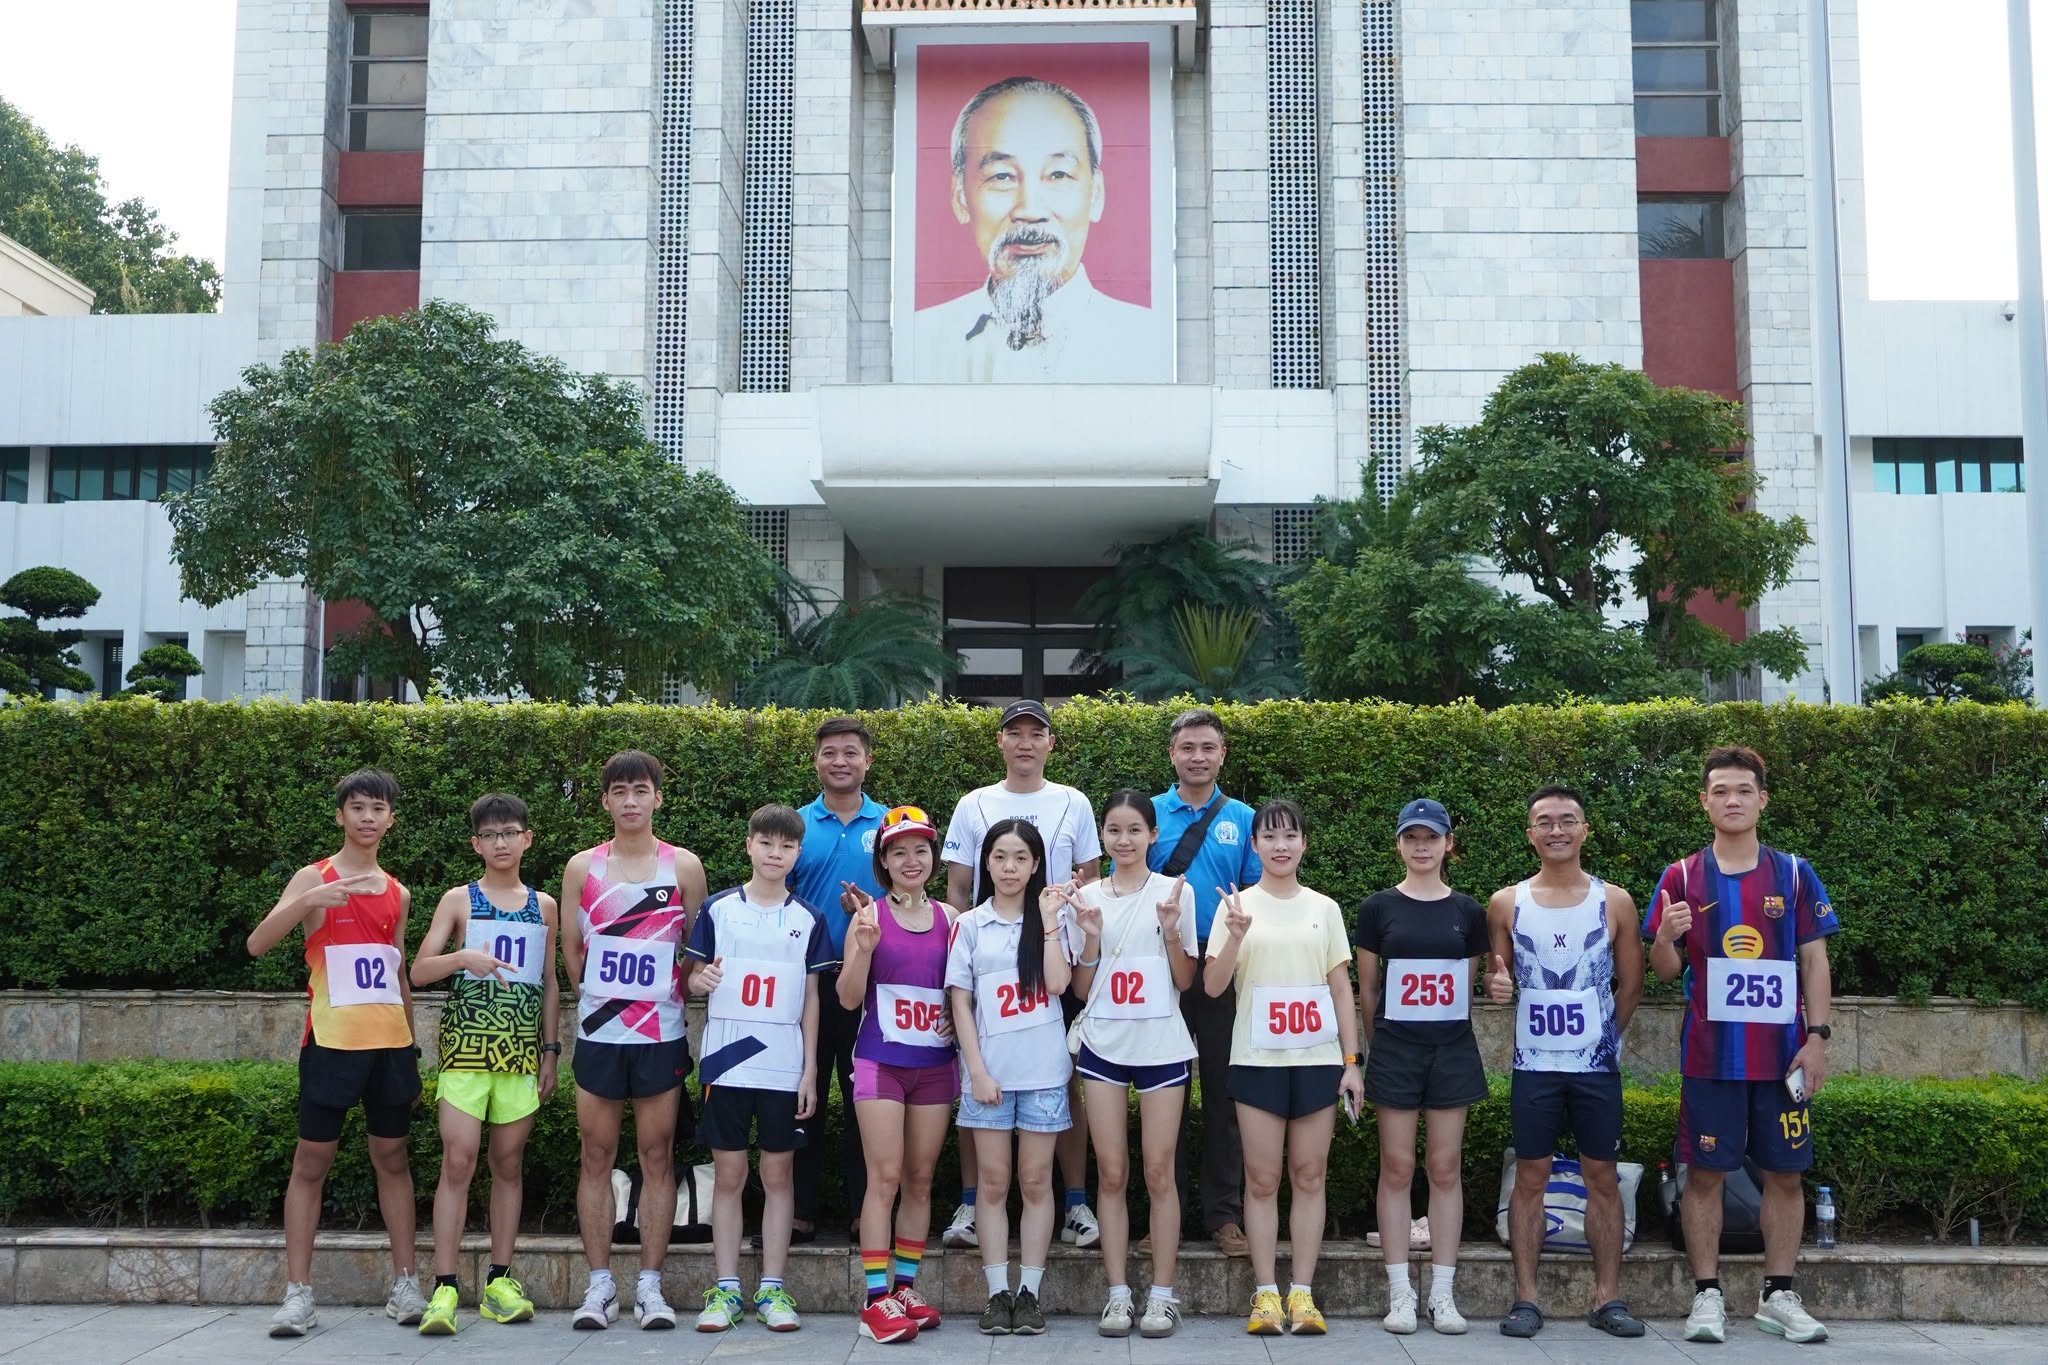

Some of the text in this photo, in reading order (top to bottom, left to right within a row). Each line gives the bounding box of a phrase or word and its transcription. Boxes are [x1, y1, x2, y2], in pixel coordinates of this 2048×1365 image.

[494, 934, 526, 968] 01
[354, 957, 387, 990] 02
[599, 950, 656, 988] 506
[741, 973, 775, 1008] 01
[1111, 971, 1145, 1004] 02
[1401, 973, 1455, 1006] 253
[1725, 973, 1784, 1010] 253
[1269, 1000, 1323, 1034] 506
[1530, 1002, 1586, 1037] 505
[1779, 1107, 1810, 1140] 154
